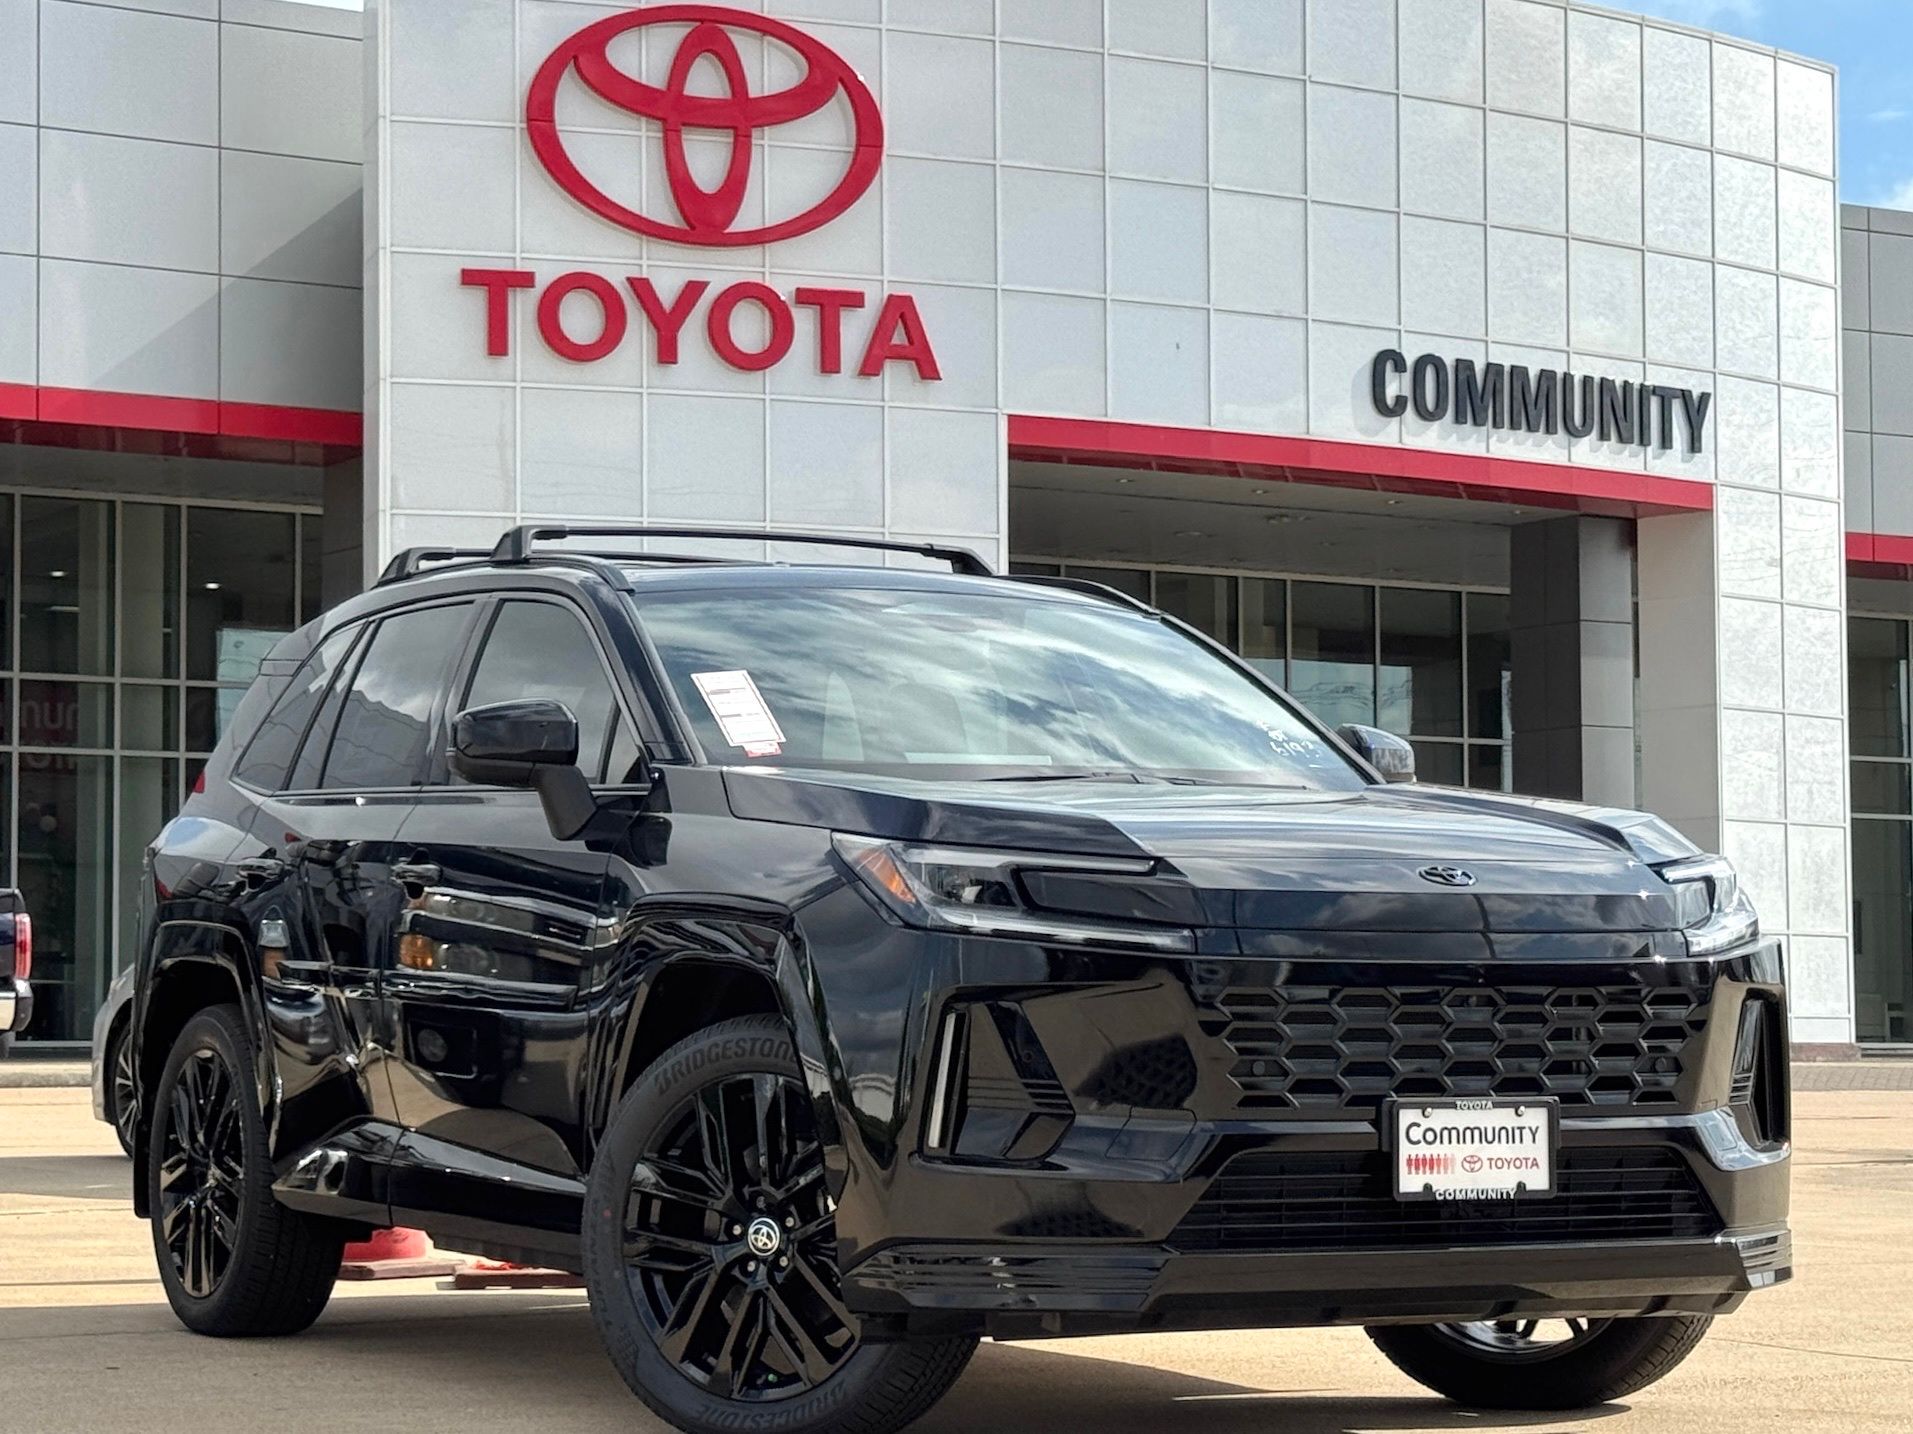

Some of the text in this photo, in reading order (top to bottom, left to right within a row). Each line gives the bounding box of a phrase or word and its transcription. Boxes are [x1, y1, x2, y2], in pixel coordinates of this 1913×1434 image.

[461, 268, 942, 381] TOYOTA
[1373, 350, 1712, 454] COMMUNITY
[653, 1036, 797, 1096] BRIDGESTON
[1455, 1100, 1494, 1110] TOYOTA
[1486, 1157, 1540, 1170] TOYOTA
[1435, 1187, 1517, 1200] COMMUNITY
